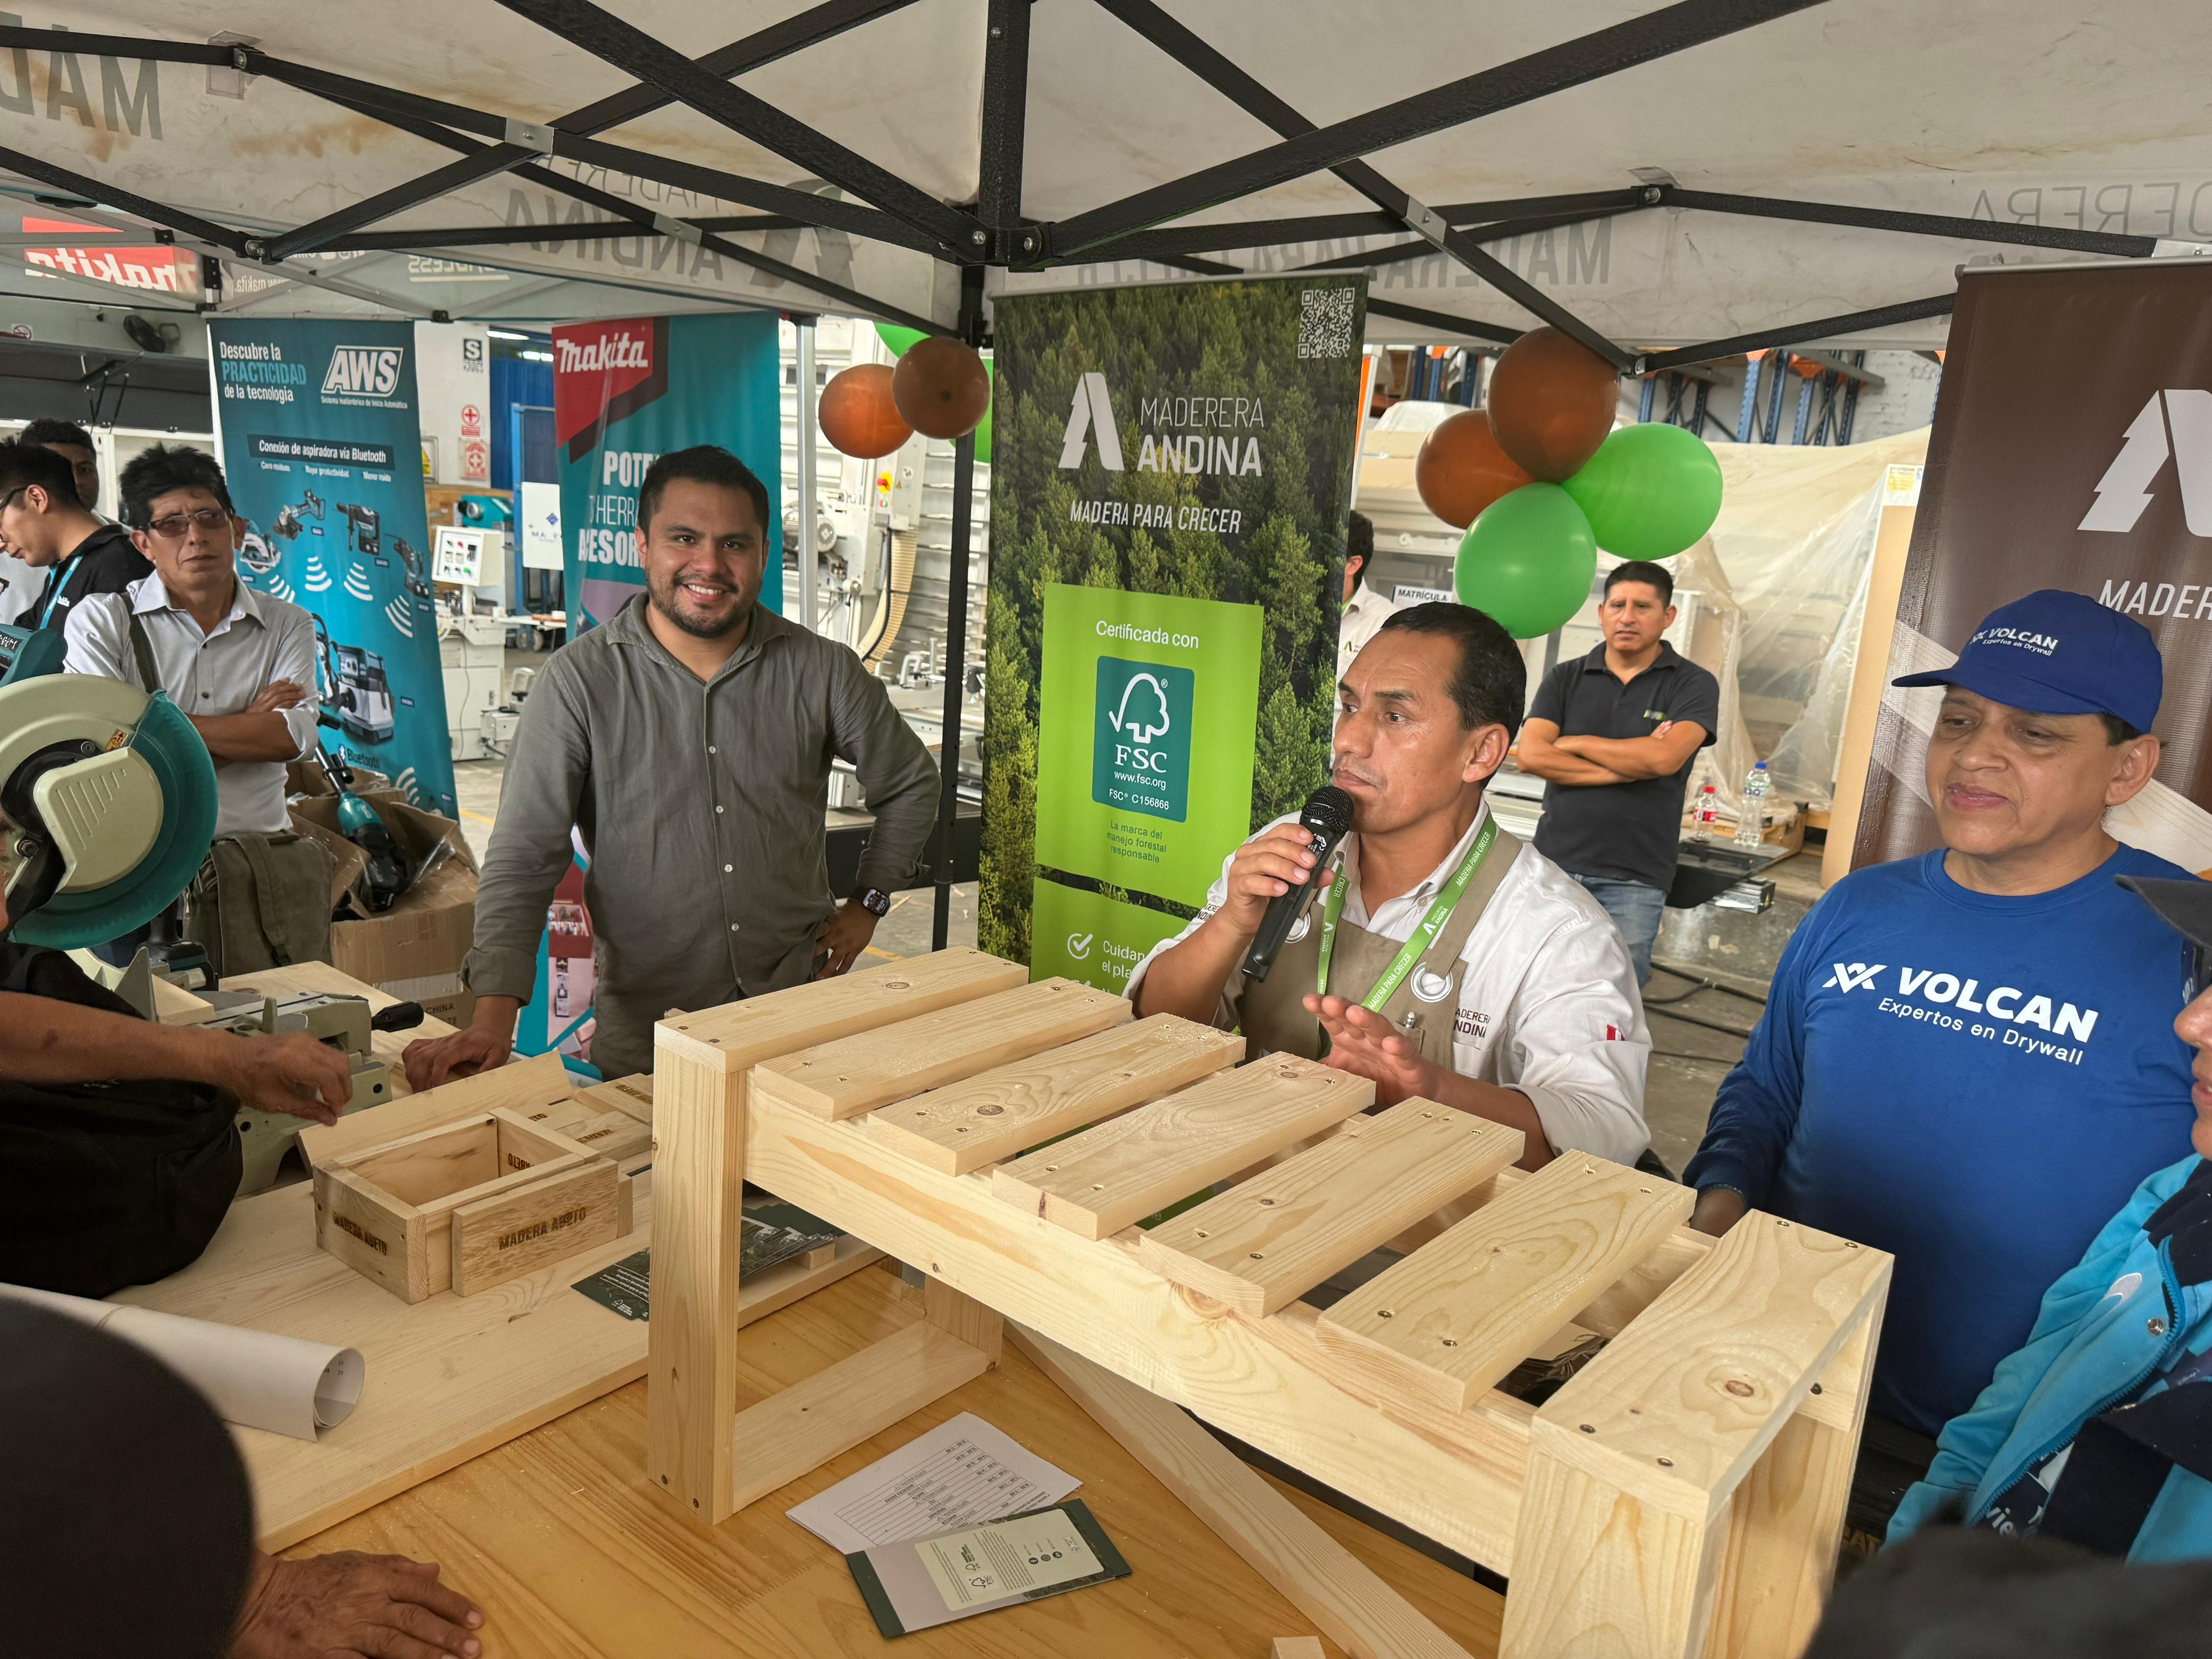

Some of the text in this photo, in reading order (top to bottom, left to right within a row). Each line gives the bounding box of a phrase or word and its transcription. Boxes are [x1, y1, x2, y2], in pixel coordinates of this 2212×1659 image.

[220, 341, 281, 361] Descubre la
[464, 340, 481, 360] S
[556, 332, 648, 373] makita
[222, 361, 307, 386] PRACTICIDAD
[325, 350, 398, 393] AWS
[224, 383, 294, 405] de la tecnología
[1141, 397, 1264, 428] MADERERA
[259, 439, 386, 464] Conexión de aspiradora vía Bluetooth
[1137, 434, 1262, 477] ANDINA
[1070, 500, 1242, 534] MADERA PARA CRECER
[1398, 589, 1447, 601] MATRÍCULA
[1096, 620, 1199, 649] Certificada con
[1988, 627, 2059, 650] VOLCAN
[2023, 643, 2054, 656] Drywall
[347, 748, 381, 769] Bluetooth
[1115, 744, 1168, 773] FSC
[1113, 770, 1167, 791] www.fsc.org
[1132, 794, 1170, 810] C156866
[1111, 819, 1162, 840] La marca del
[1107, 832, 1167, 853] manejo forestal
[1111, 845, 1160, 863] responsable
[1455, 832, 1490, 887] MADERA PARA CRECER
[1334, 876, 1346, 898] CRECER
[1102, 960, 1111, 973] el
[1368, 952, 1412, 1010] MADERA PARA CRECER
[1899, 967, 2099, 1043] VOLCAN
[1878, 998, 2084, 1065] Expertos en Drywall
[332, 1211, 364, 1242] MADERA
[498, 1224, 549, 1251] MADERA
[983, 1574, 992, 1585] FSC
